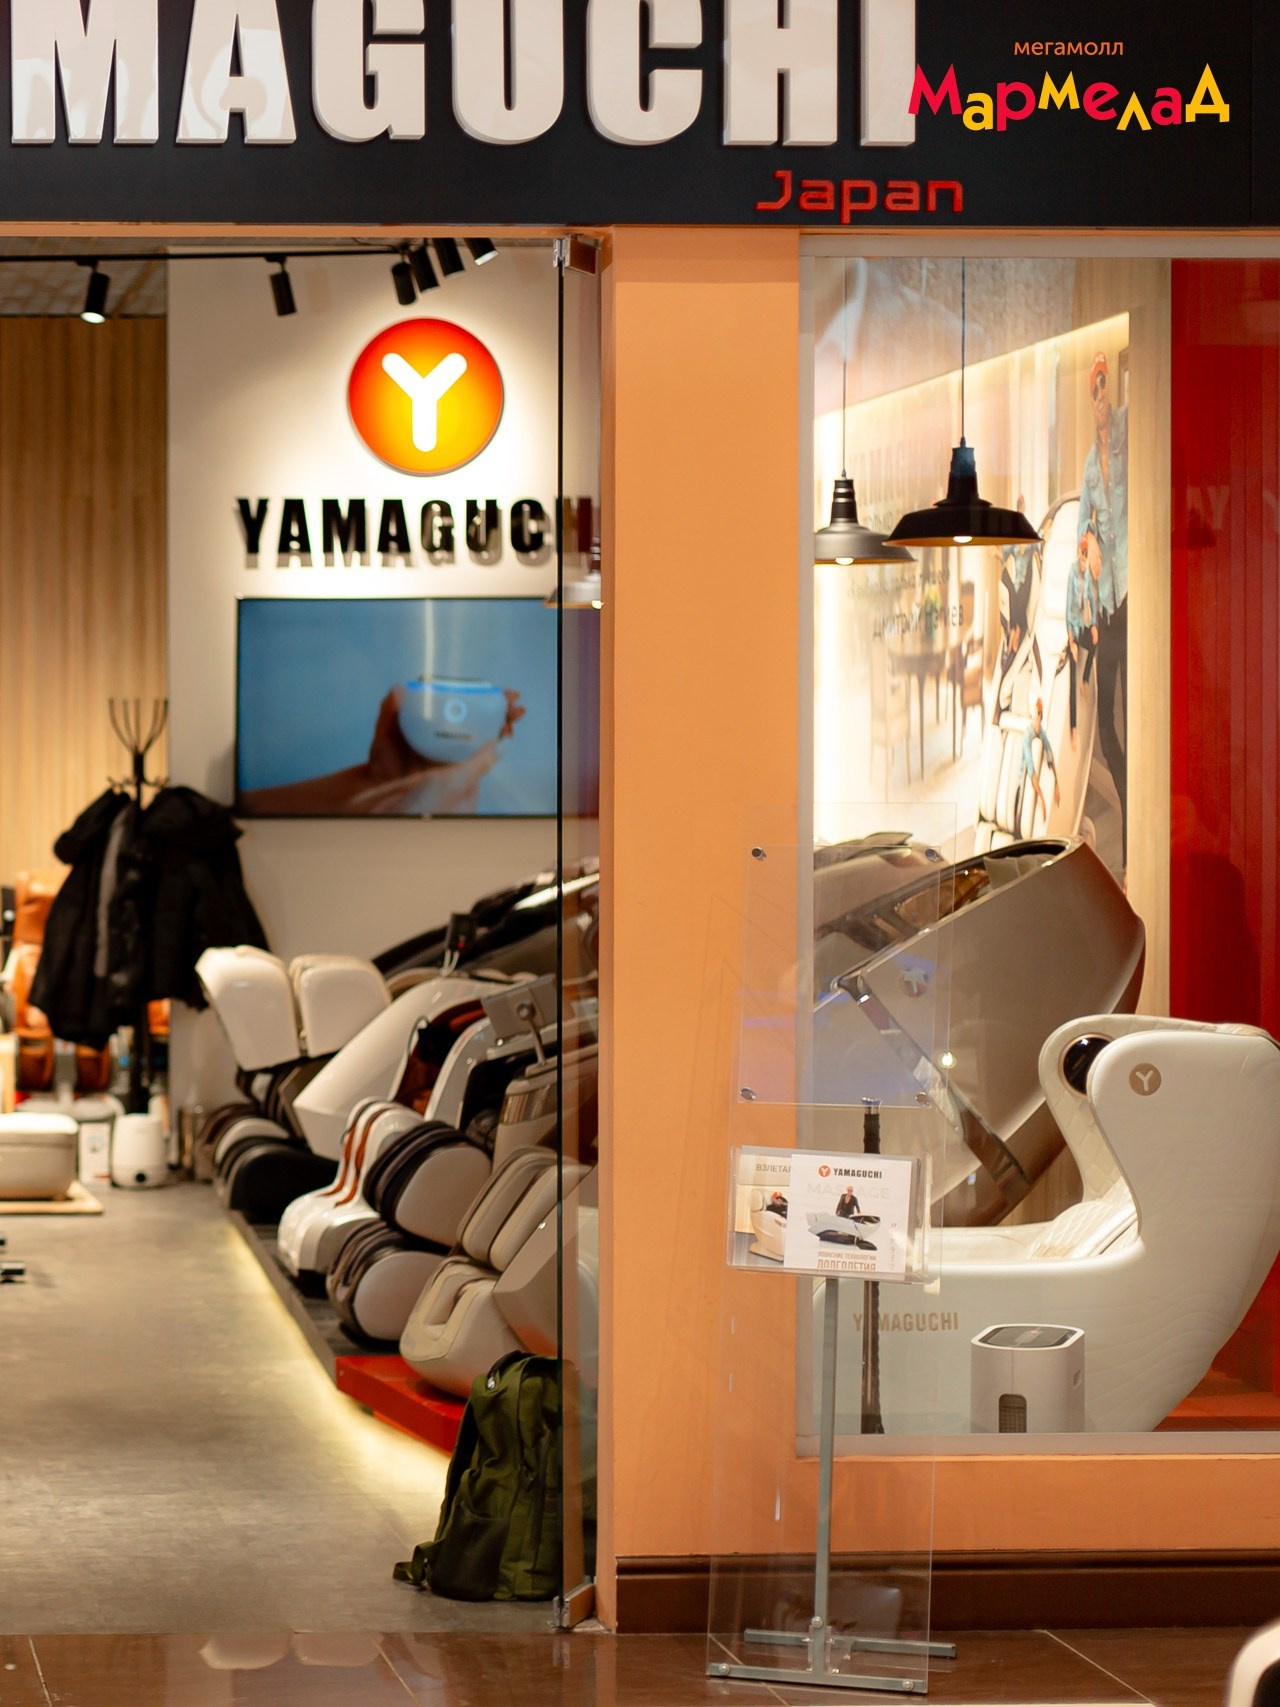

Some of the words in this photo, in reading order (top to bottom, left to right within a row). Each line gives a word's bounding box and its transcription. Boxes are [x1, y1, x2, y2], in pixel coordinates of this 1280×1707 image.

[756, 170, 964, 224] Japan
[833, 1167, 882, 1179] YAMAGUCHI
[853, 1312, 958, 1332] YMAGUCHI
